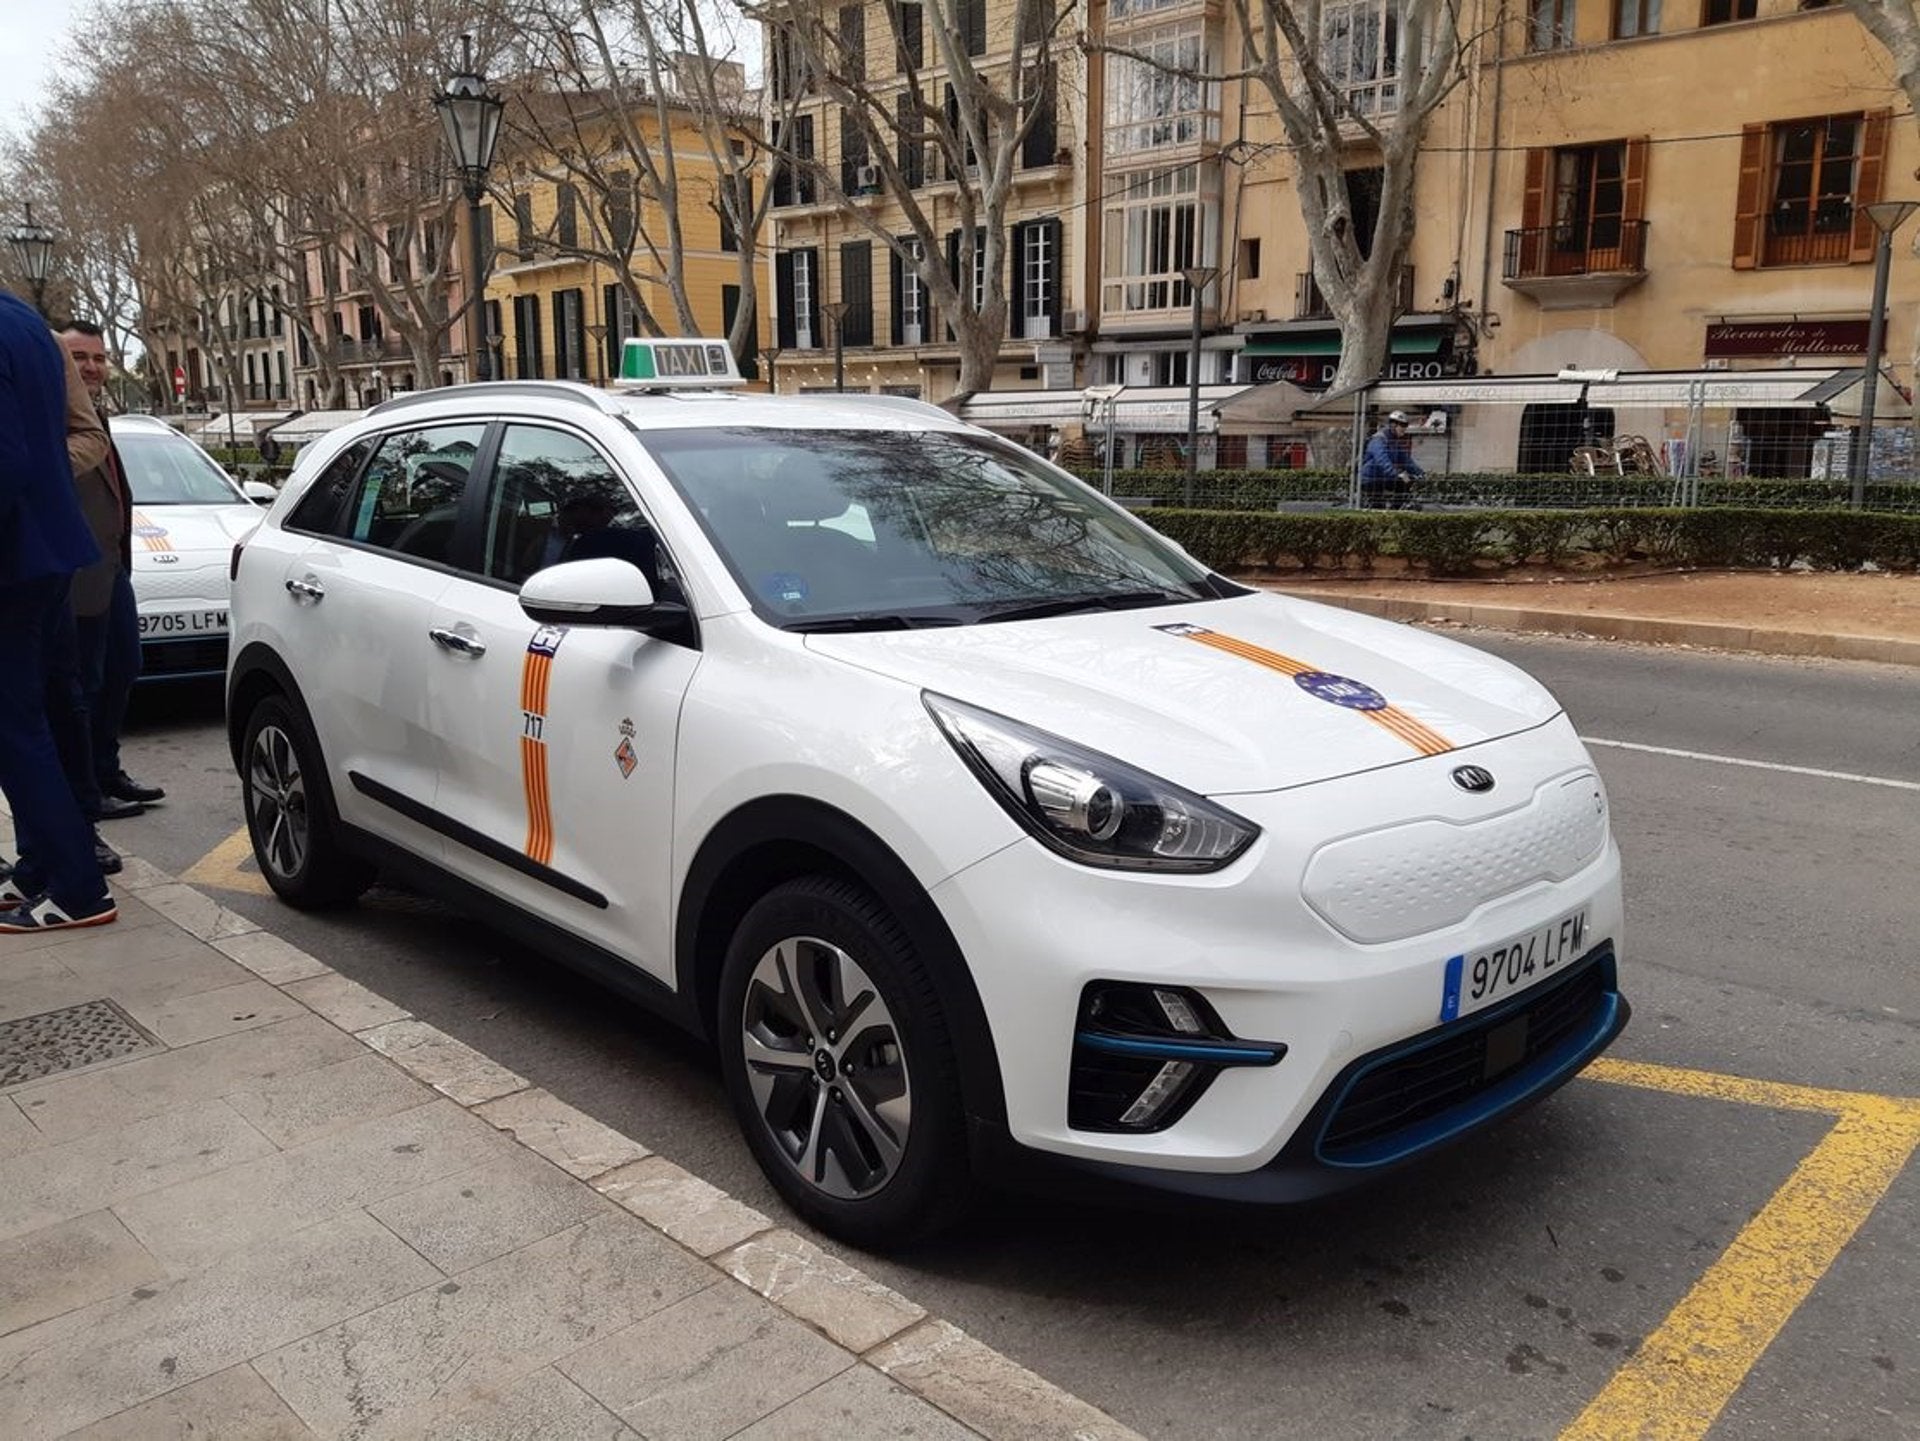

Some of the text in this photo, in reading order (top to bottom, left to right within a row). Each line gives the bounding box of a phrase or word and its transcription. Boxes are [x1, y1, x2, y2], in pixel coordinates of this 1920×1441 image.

[1711, 325, 1807, 340] Recuerdos
[1773, 339, 1861, 353] Mallorca
[656, 347, 704, 375] TAXI
[1389, 361, 1442, 379] IERO
[138, 612, 228, 633] 9705 LFM
[1317, 682, 1361, 697] TAXI
[523, 712, 543, 739] 717
[1455, 767, 1494, 788] KIA
[1471, 936, 1536, 1000] 9704
[1544, 911, 1585, 969] LFM
